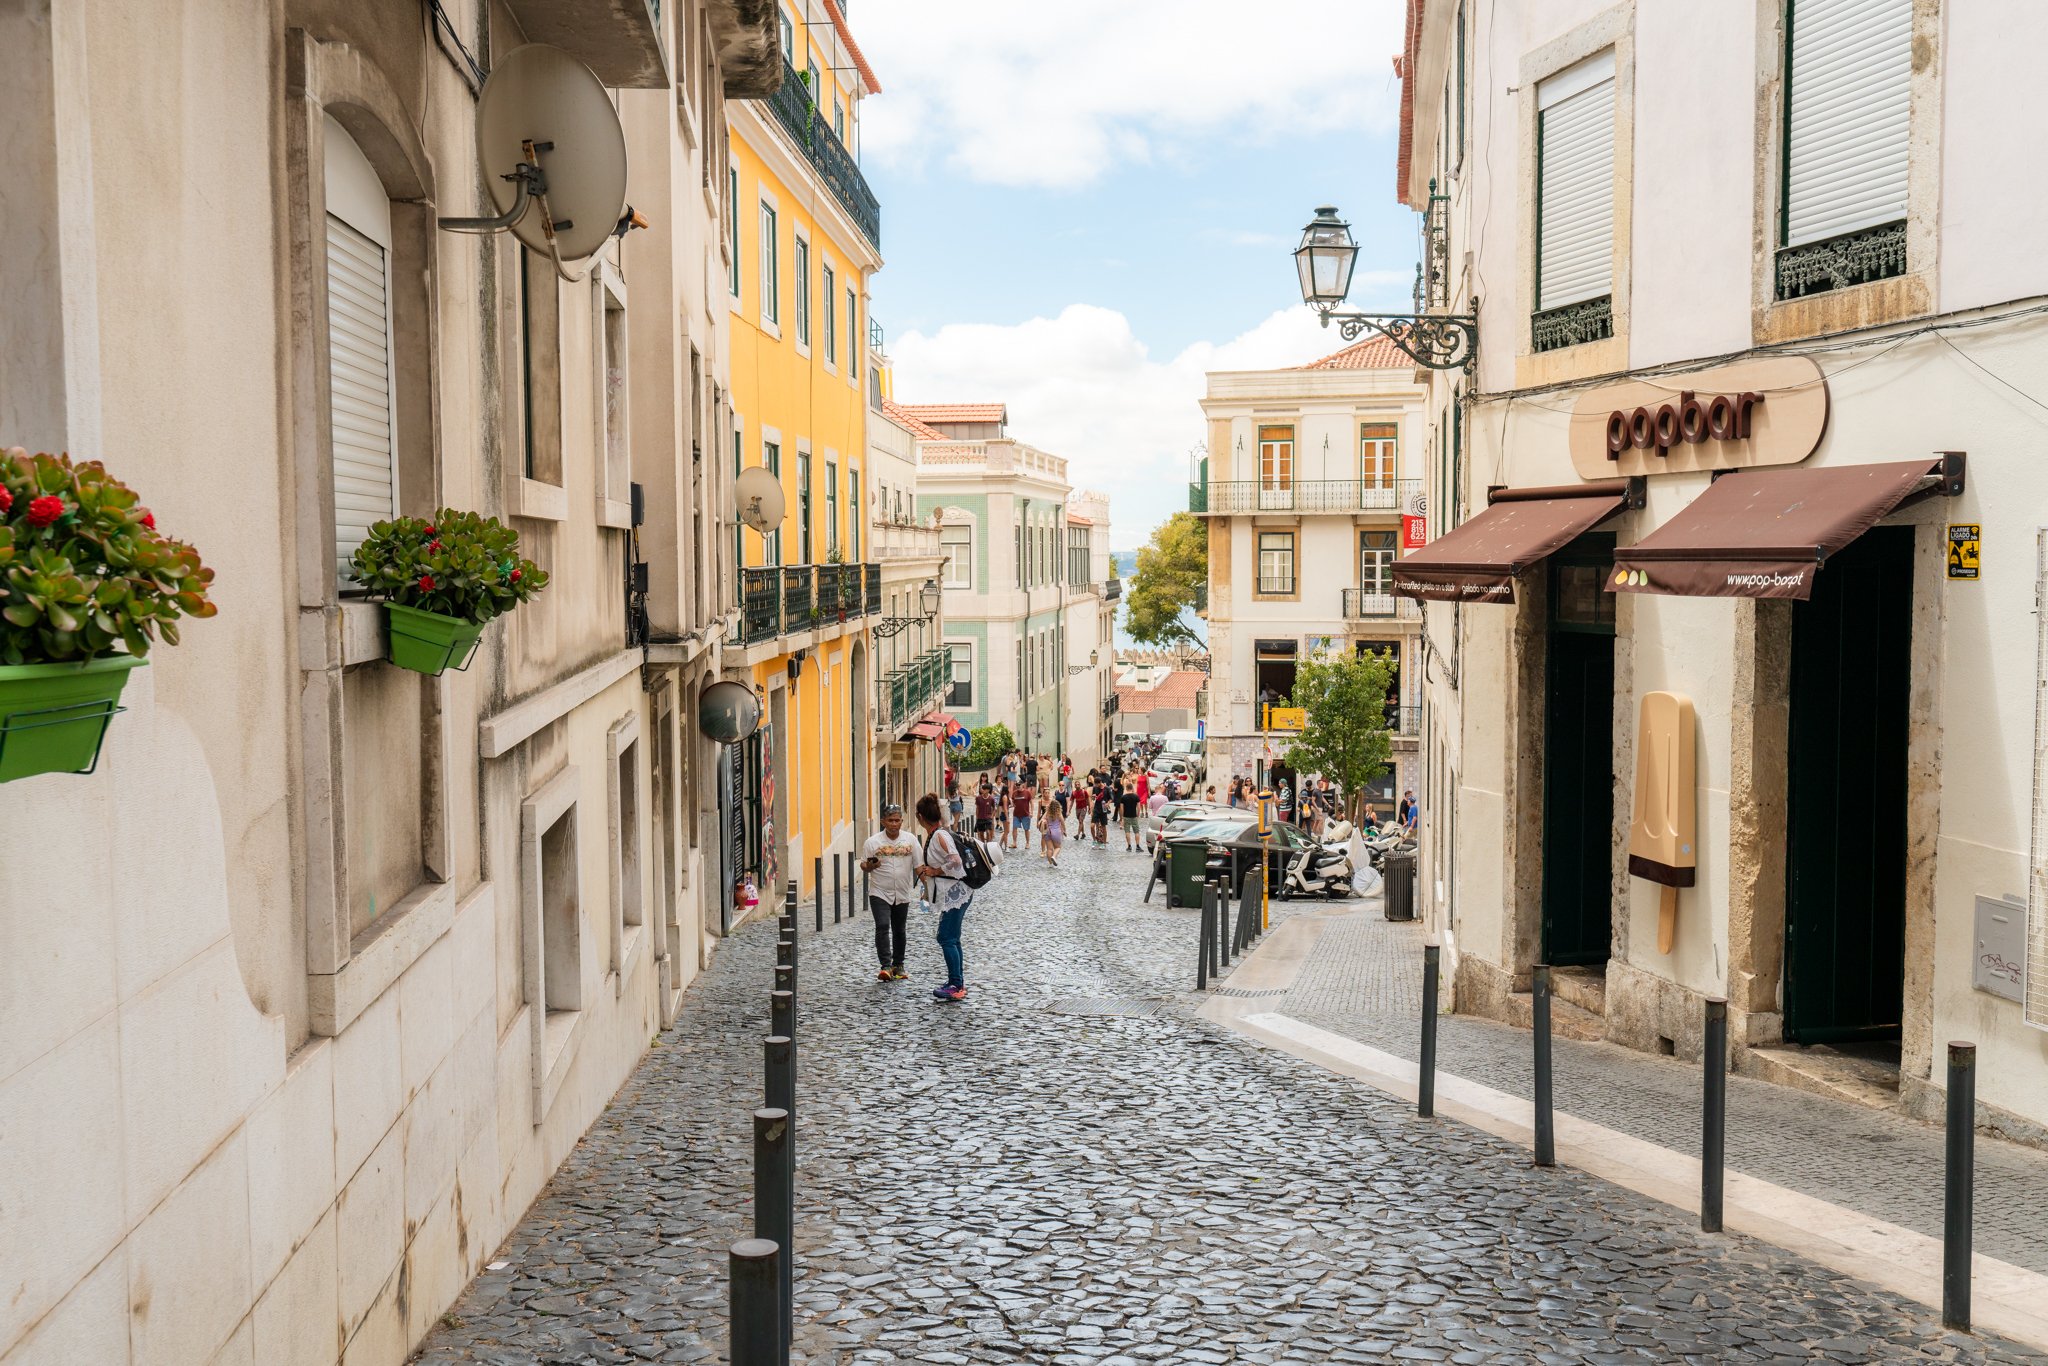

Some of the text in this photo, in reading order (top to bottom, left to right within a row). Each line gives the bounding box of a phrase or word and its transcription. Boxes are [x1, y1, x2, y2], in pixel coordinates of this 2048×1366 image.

[1606, 390, 1765, 461] popbar
[1411, 519, 1424, 527] 215
[1411, 532, 1425, 540] 622
